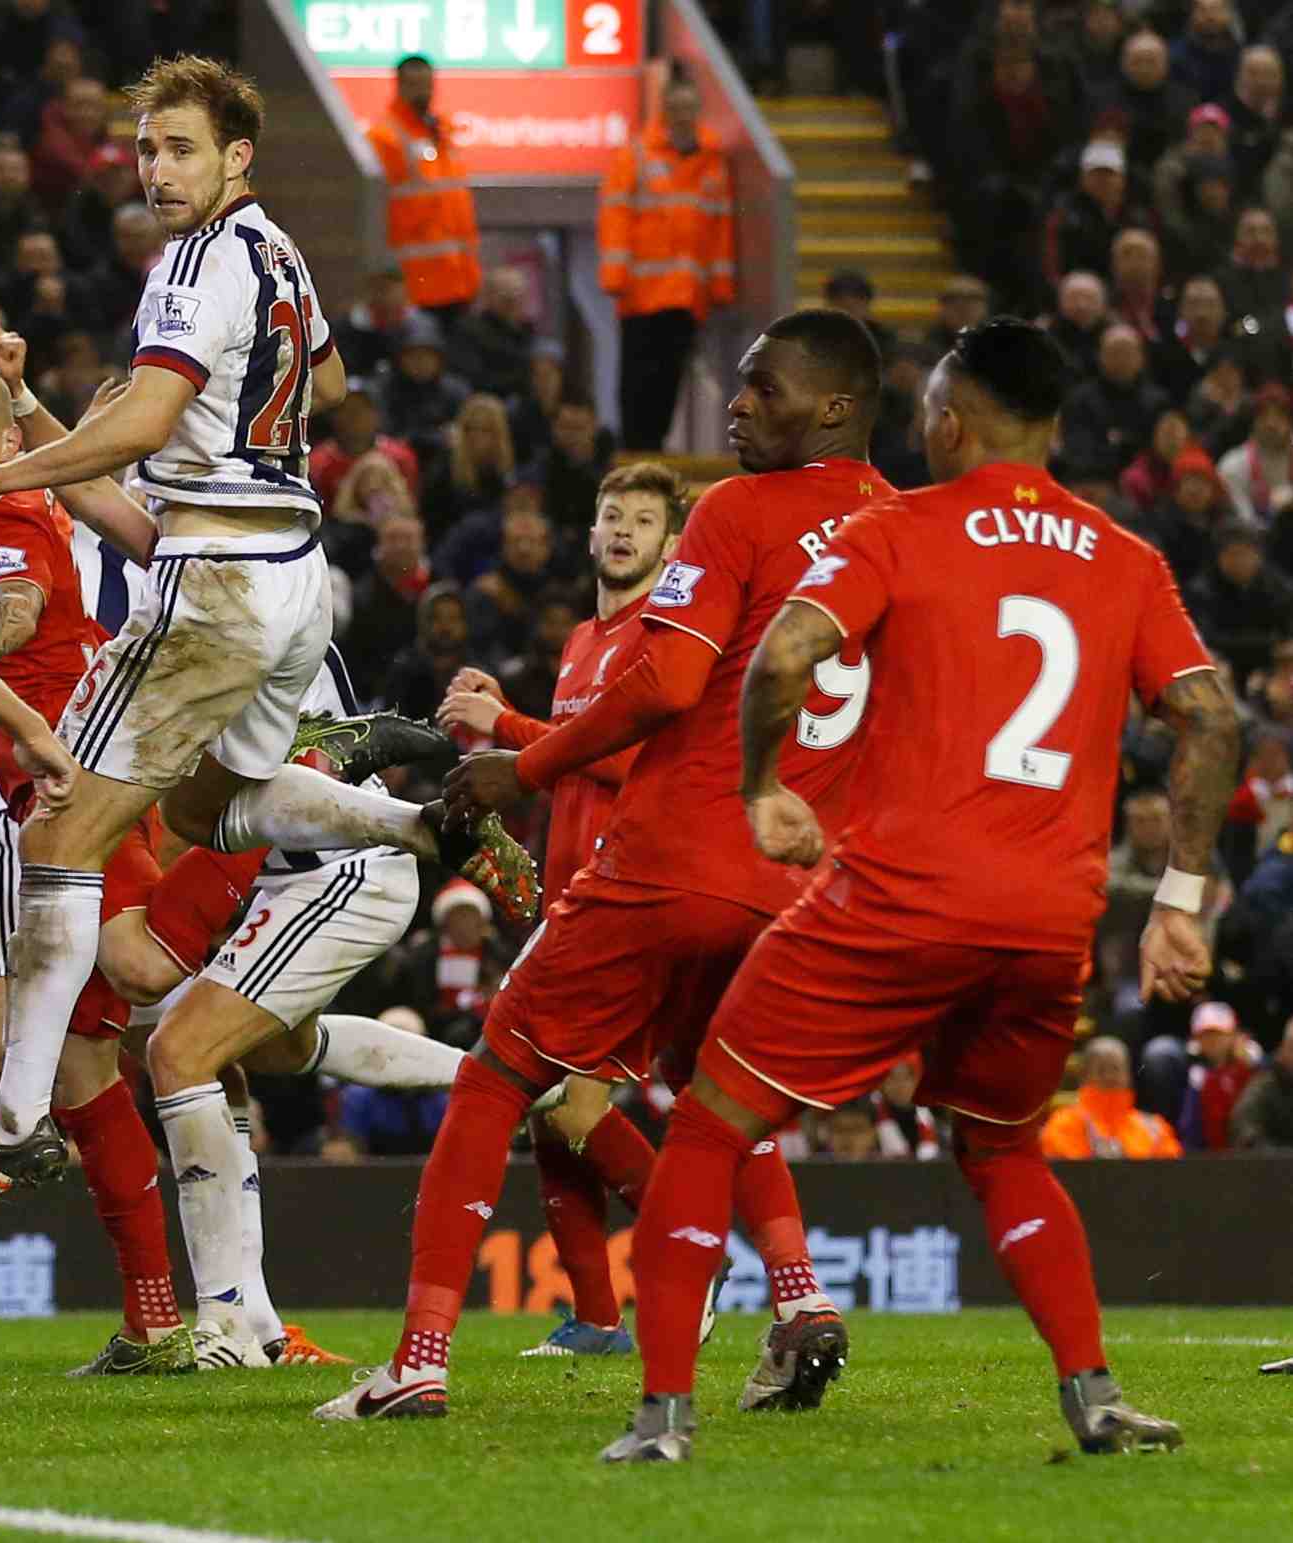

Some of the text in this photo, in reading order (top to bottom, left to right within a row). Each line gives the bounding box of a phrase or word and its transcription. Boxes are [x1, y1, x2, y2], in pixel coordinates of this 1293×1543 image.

[307, 2, 622, 54] EXIT 2
[964, 507, 1098, 561] CLYNE
[796, 651, 871, 749] 9
[984, 594, 1080, 791] 2
